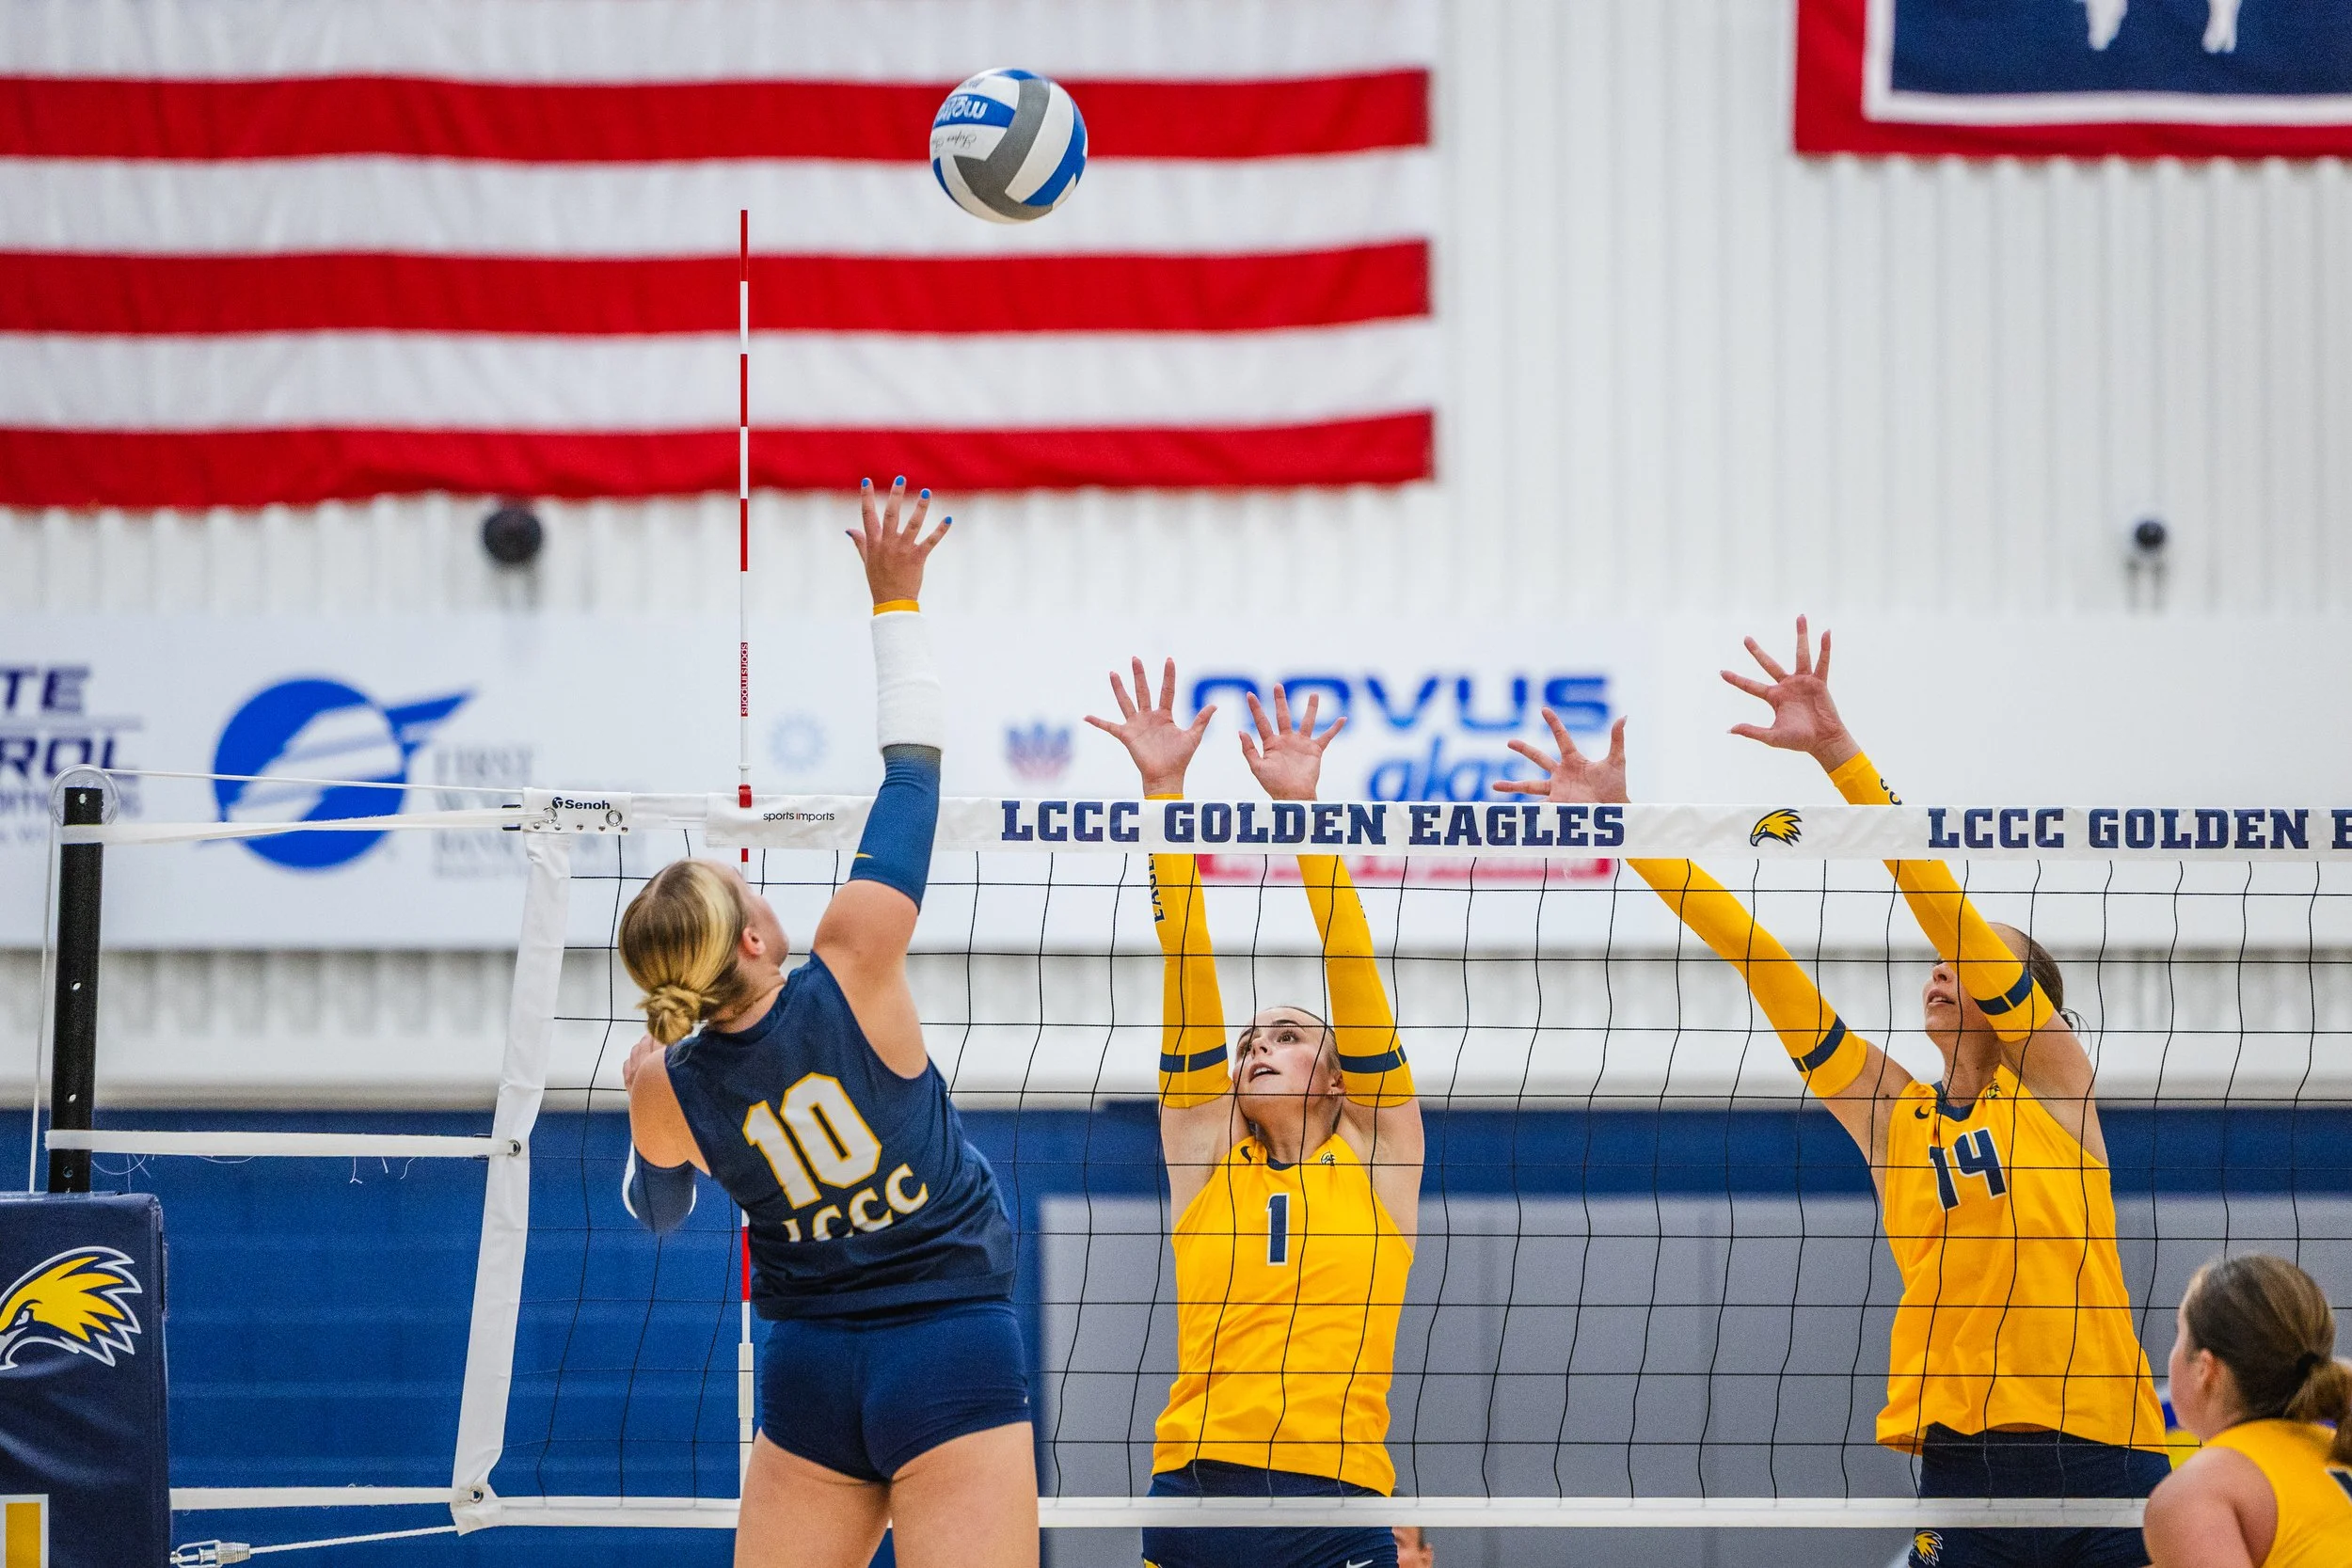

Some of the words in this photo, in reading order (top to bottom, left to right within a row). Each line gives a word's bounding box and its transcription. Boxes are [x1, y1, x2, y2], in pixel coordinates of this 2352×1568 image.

[564, 800, 611, 811] Senoh
[763, 811, 795, 823] sports
[796, 811, 835, 823] imports
[1001, 800, 1140, 842] LCCC
[1164, 801, 1388, 845] GOLDEN
[1408, 804, 1625, 847] EAGLES
[1927, 808, 2065, 849] LCCC
[2088, 808, 2311, 850] GOLDEN
[741, 1071, 882, 1211] 10
[1929, 1128, 2008, 1212] 14
[1265, 1193, 1290, 1267] 1
